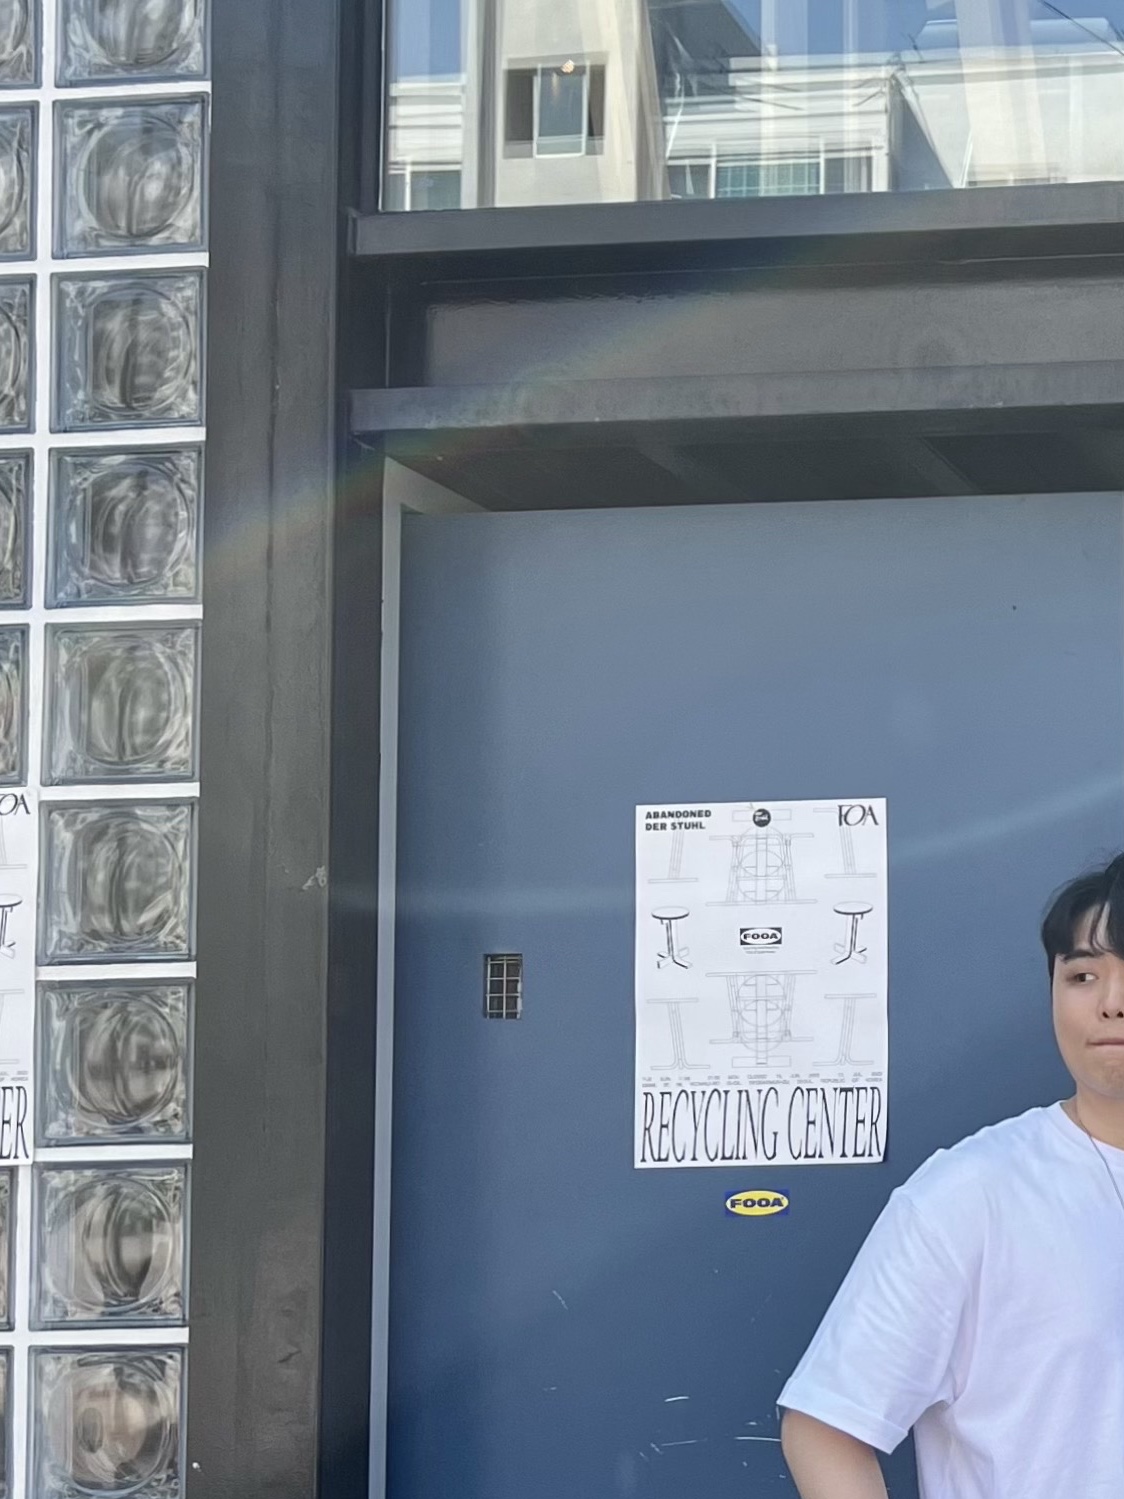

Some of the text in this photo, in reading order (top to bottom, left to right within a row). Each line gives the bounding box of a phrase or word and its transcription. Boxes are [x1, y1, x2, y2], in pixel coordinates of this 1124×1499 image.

[0, 793, 30, 816] OA
[645, 809, 712, 820] ABANDONED
[838, 804, 879, 827] FOA
[645, 821, 706, 831] DER STUHL
[743, 932, 778, 941] FOOA
[640, 1086, 882, 1163] RECYCLING CENTER
[730, 1197, 784, 1209] FOOA
